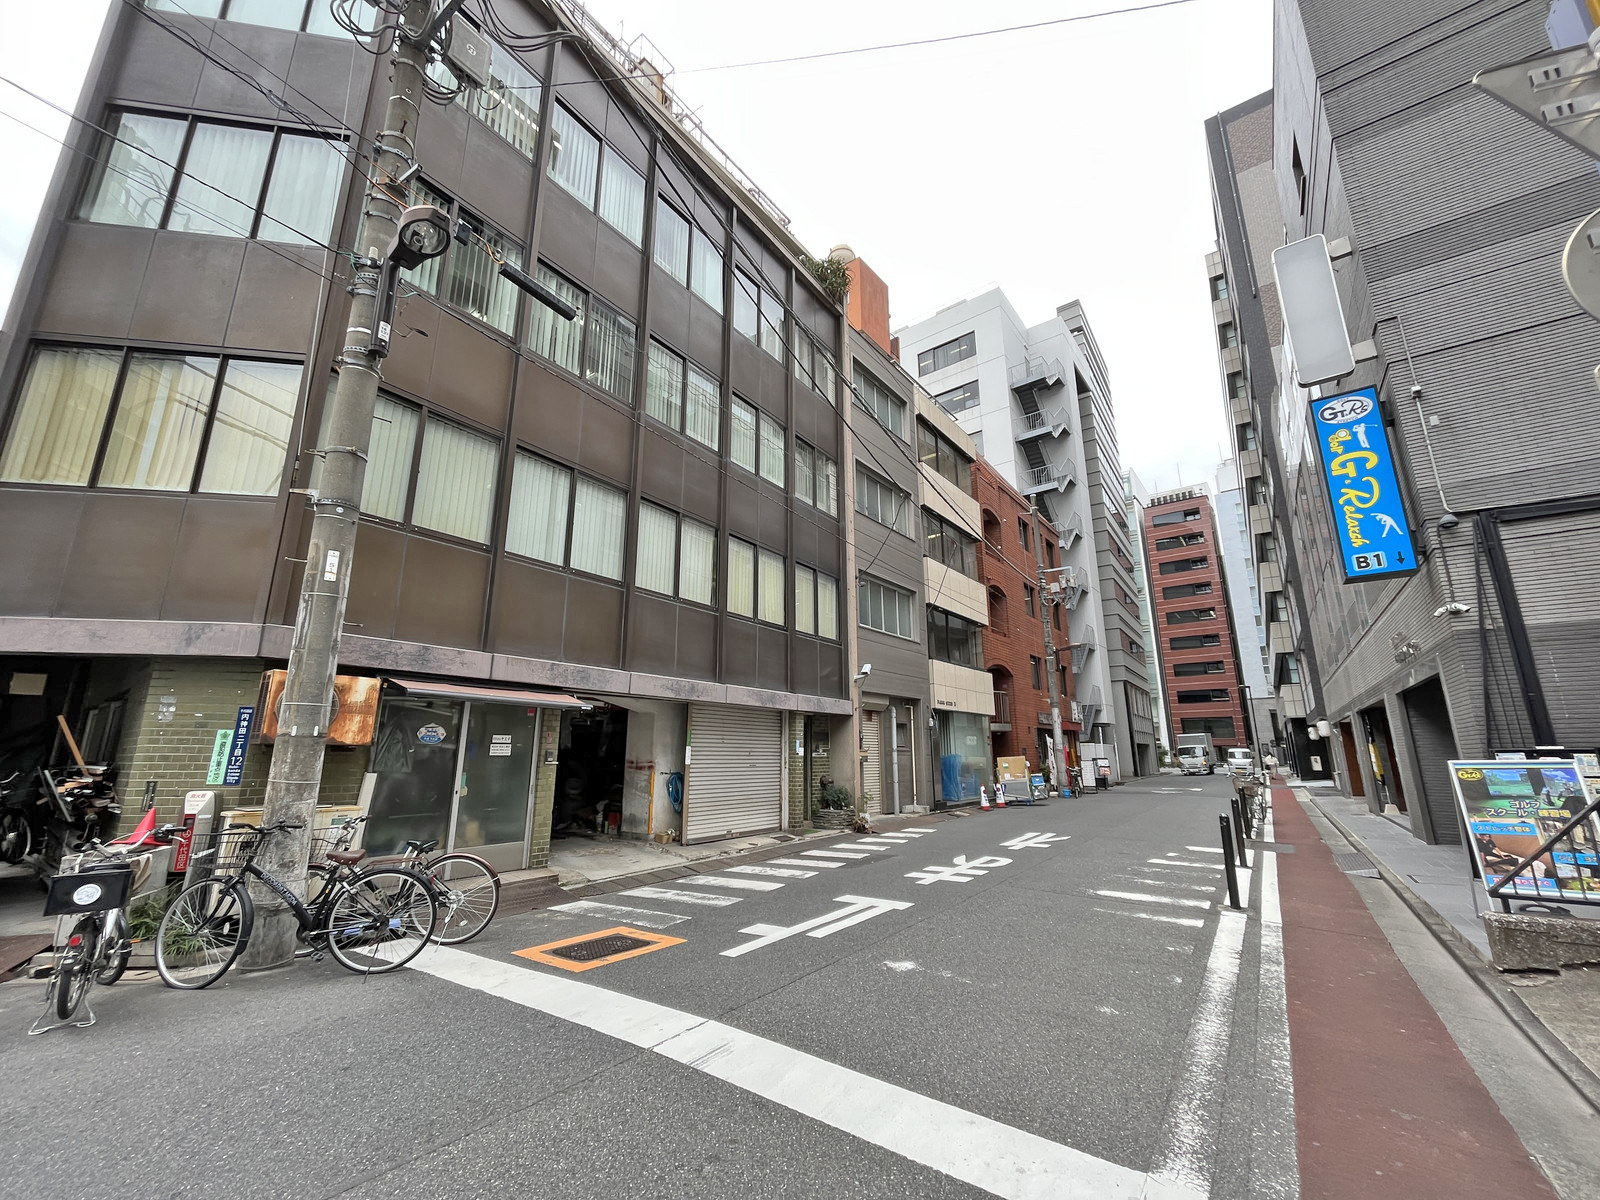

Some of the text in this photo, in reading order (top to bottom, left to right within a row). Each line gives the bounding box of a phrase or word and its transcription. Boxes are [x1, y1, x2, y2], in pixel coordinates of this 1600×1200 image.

[1355, 553, 1383, 570] B1
[230, 756, 243, 765] 12
[1510, 800, 1540, 809] ゴルフ
